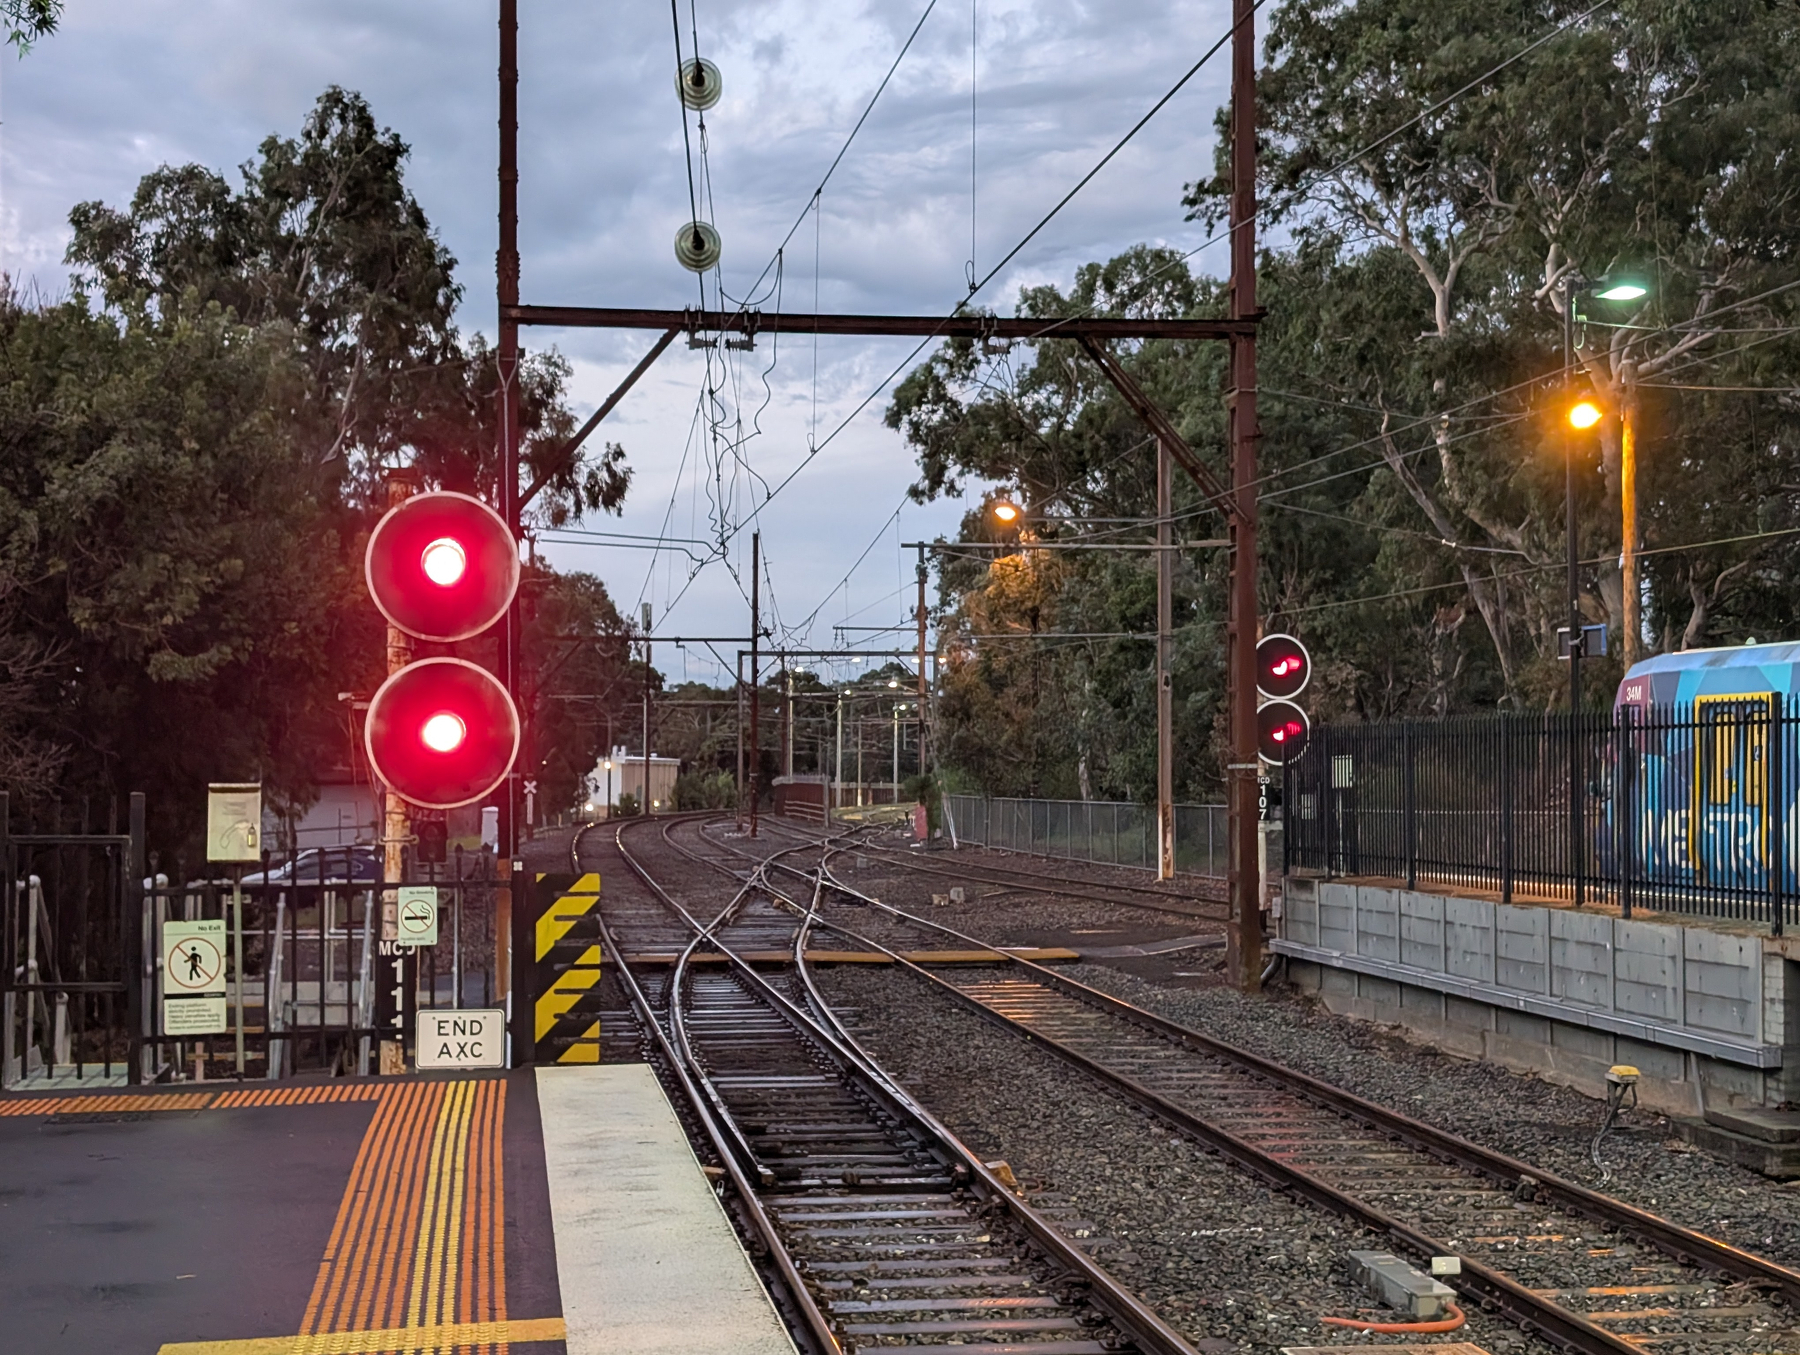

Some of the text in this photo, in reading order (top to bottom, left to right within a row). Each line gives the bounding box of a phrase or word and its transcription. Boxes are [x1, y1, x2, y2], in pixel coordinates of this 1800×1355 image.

[1626, 685, 1642, 701] 34M
[1257, 776, 1270, 784] CD
[1258, 784, 1267, 820] 107
[437, 1020, 483, 1036] END
[437, 1042, 483, 1059] AXC
